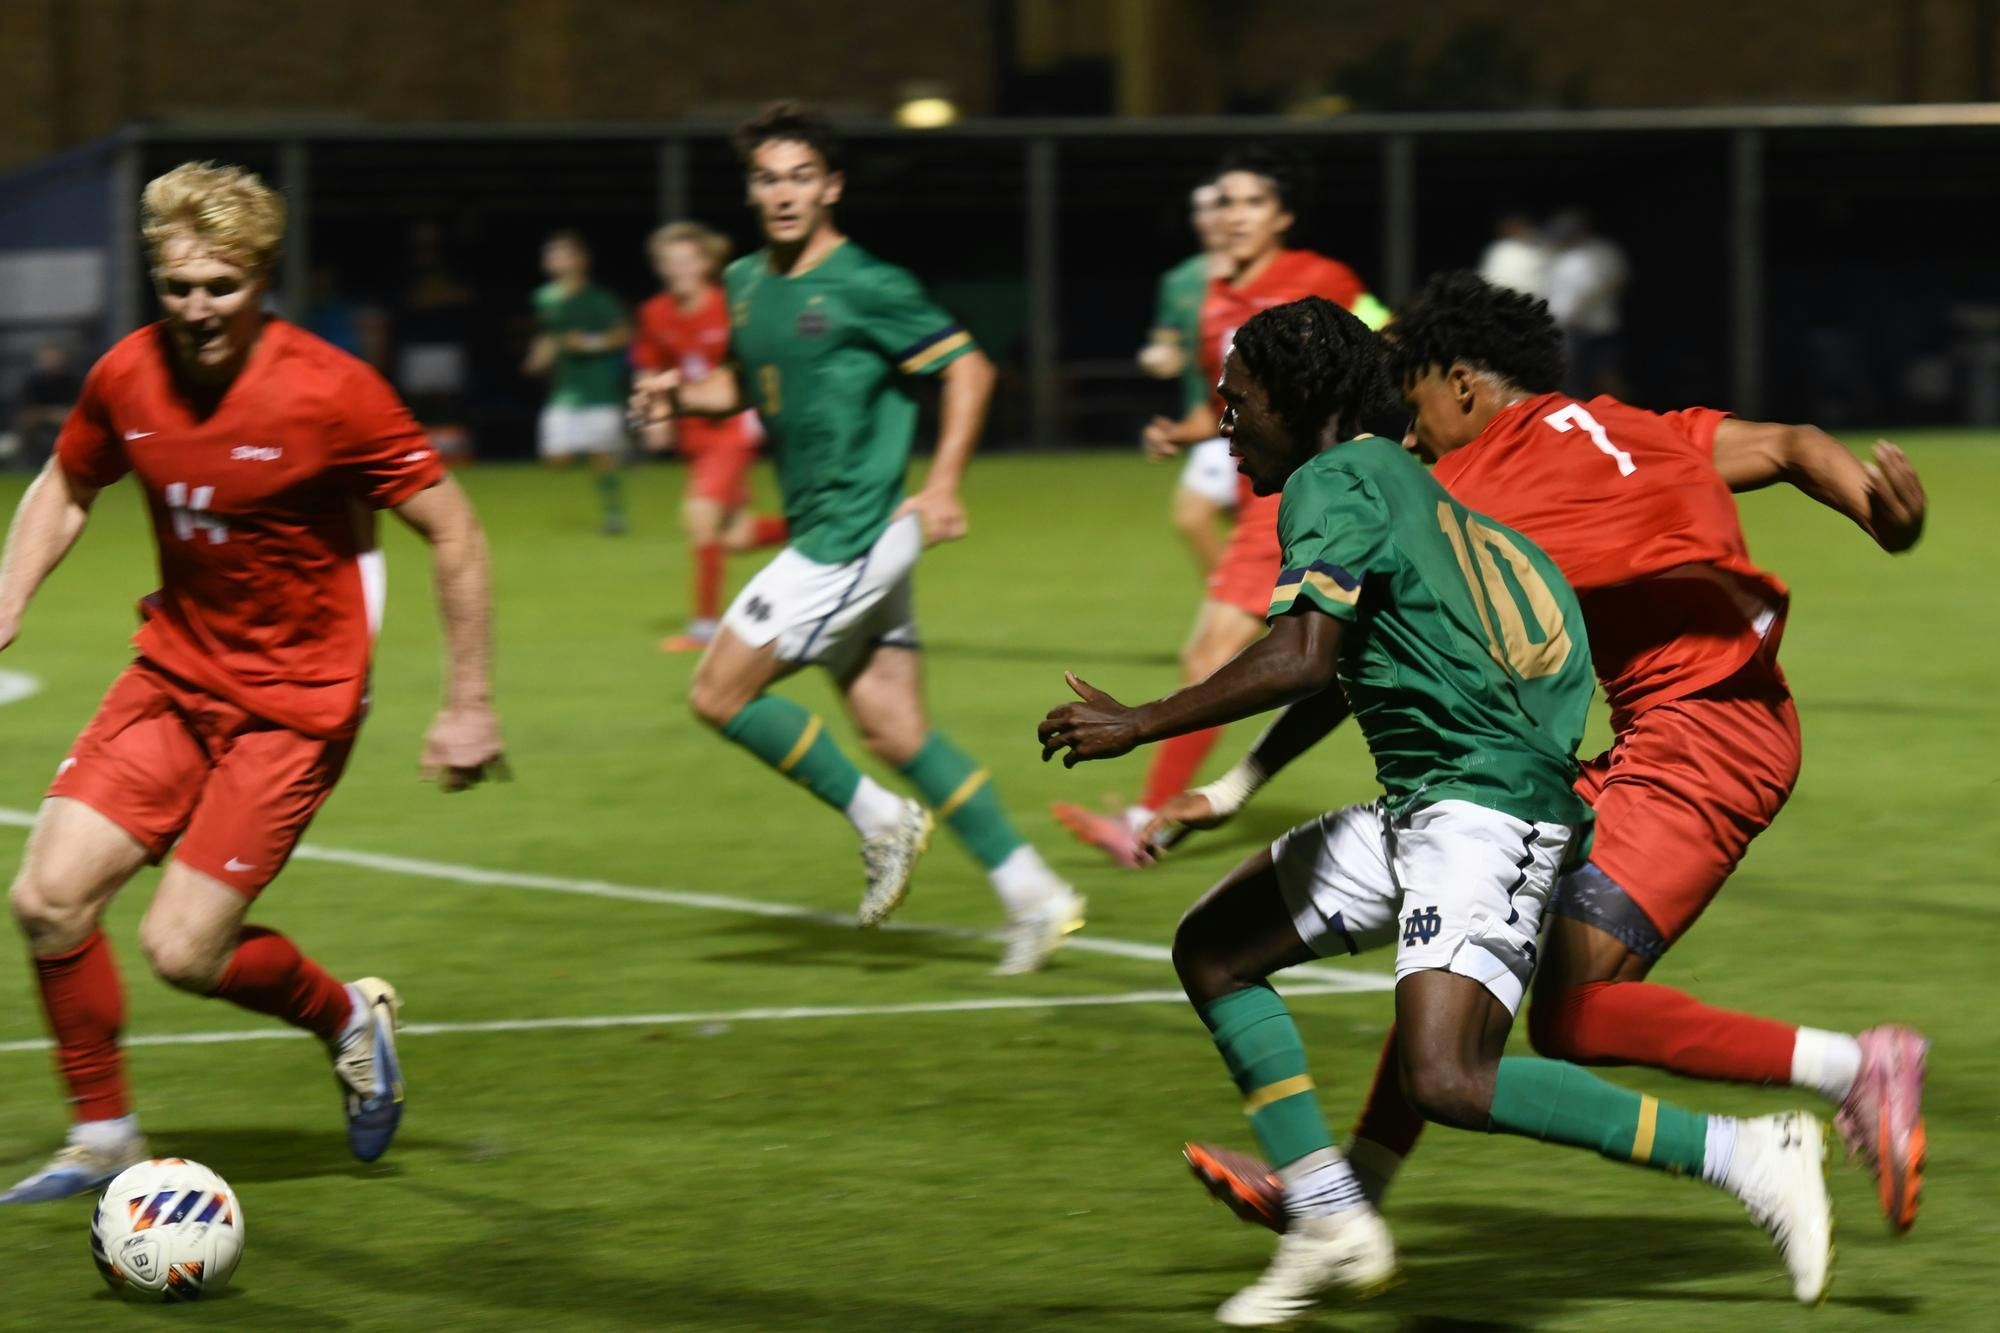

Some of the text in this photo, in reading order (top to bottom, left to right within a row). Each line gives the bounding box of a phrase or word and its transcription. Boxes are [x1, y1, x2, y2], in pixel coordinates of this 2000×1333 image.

[1542, 402, 1638, 478] 7
[165, 481, 229, 545] 14
[1436, 500, 1573, 680] 10
